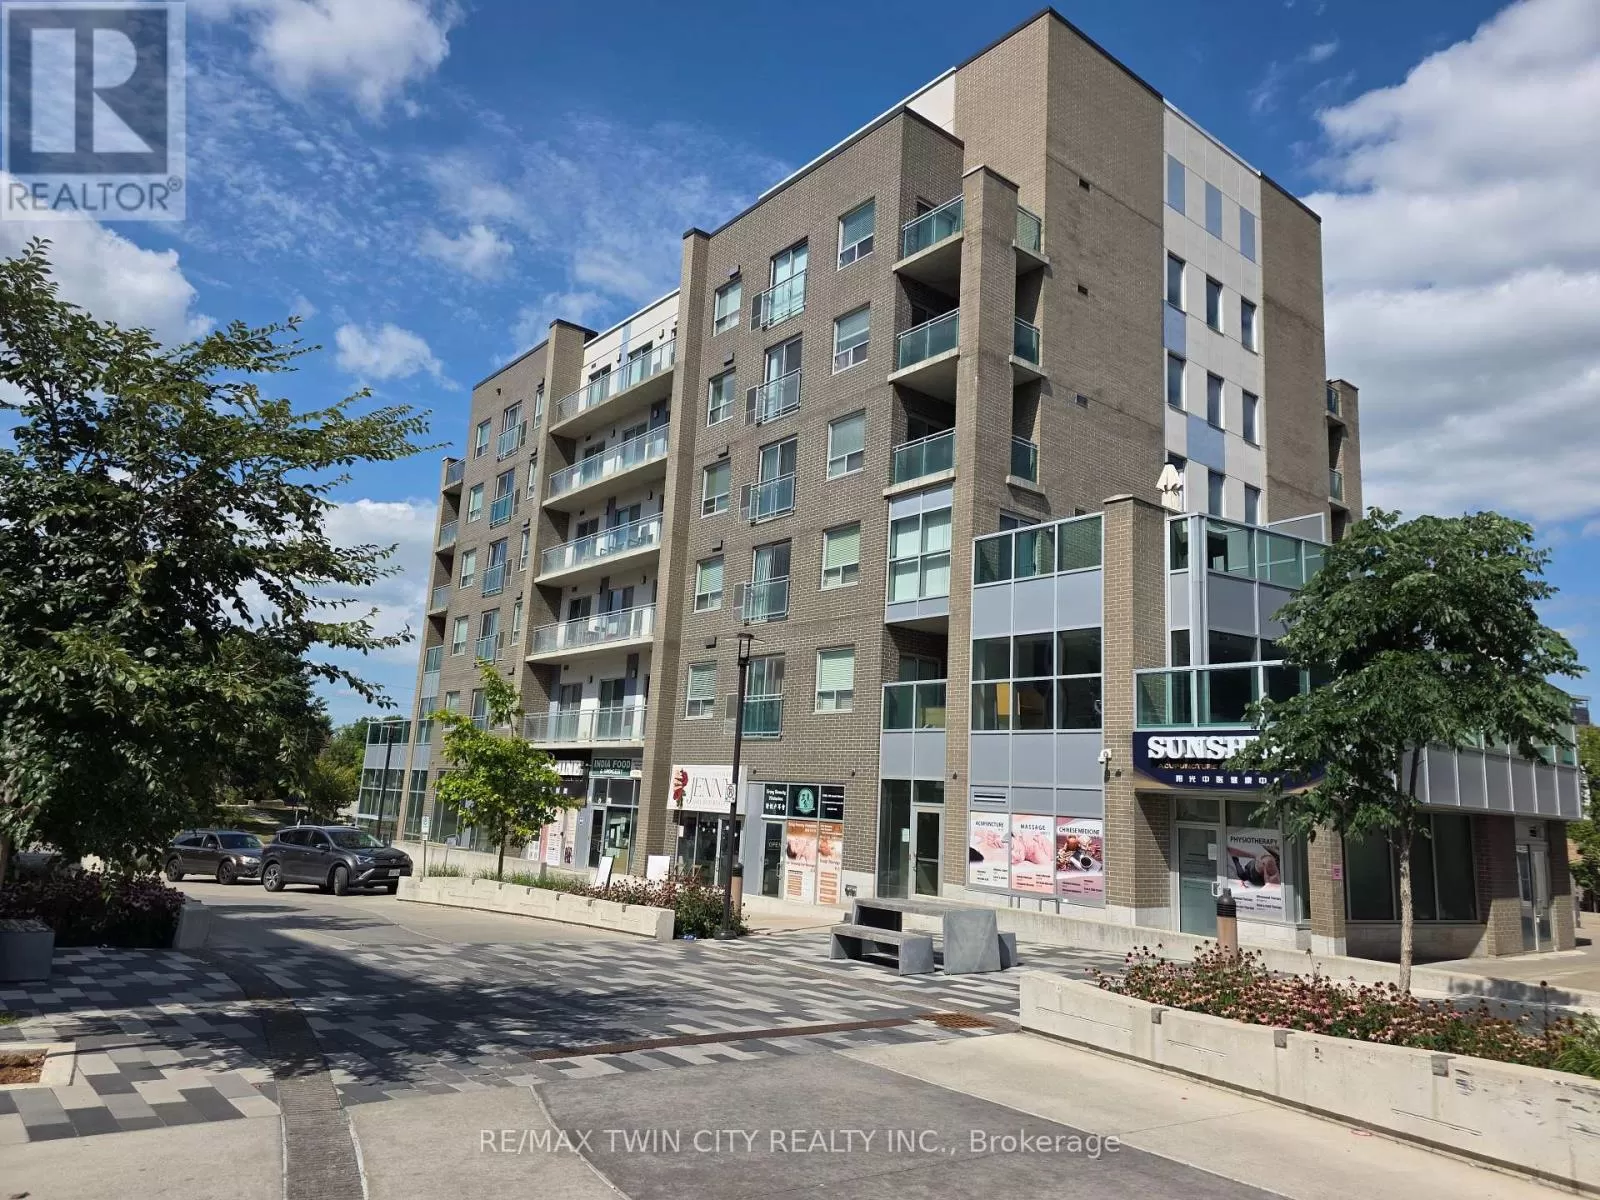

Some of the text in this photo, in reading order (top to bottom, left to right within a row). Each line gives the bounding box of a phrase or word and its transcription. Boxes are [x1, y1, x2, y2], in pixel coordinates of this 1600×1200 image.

[1147, 735, 1297, 760] SUNSH
[594, 760, 631, 769] INDIA FOOD
[975, 820, 1004, 829] ACUPUNCTURE
[1020, 823, 1046, 831] MASSAGE
[1059, 827, 1100, 836] CHINESE MEDICINE
[1230, 835, 1277, 846] PHYSIOTHERAPY
